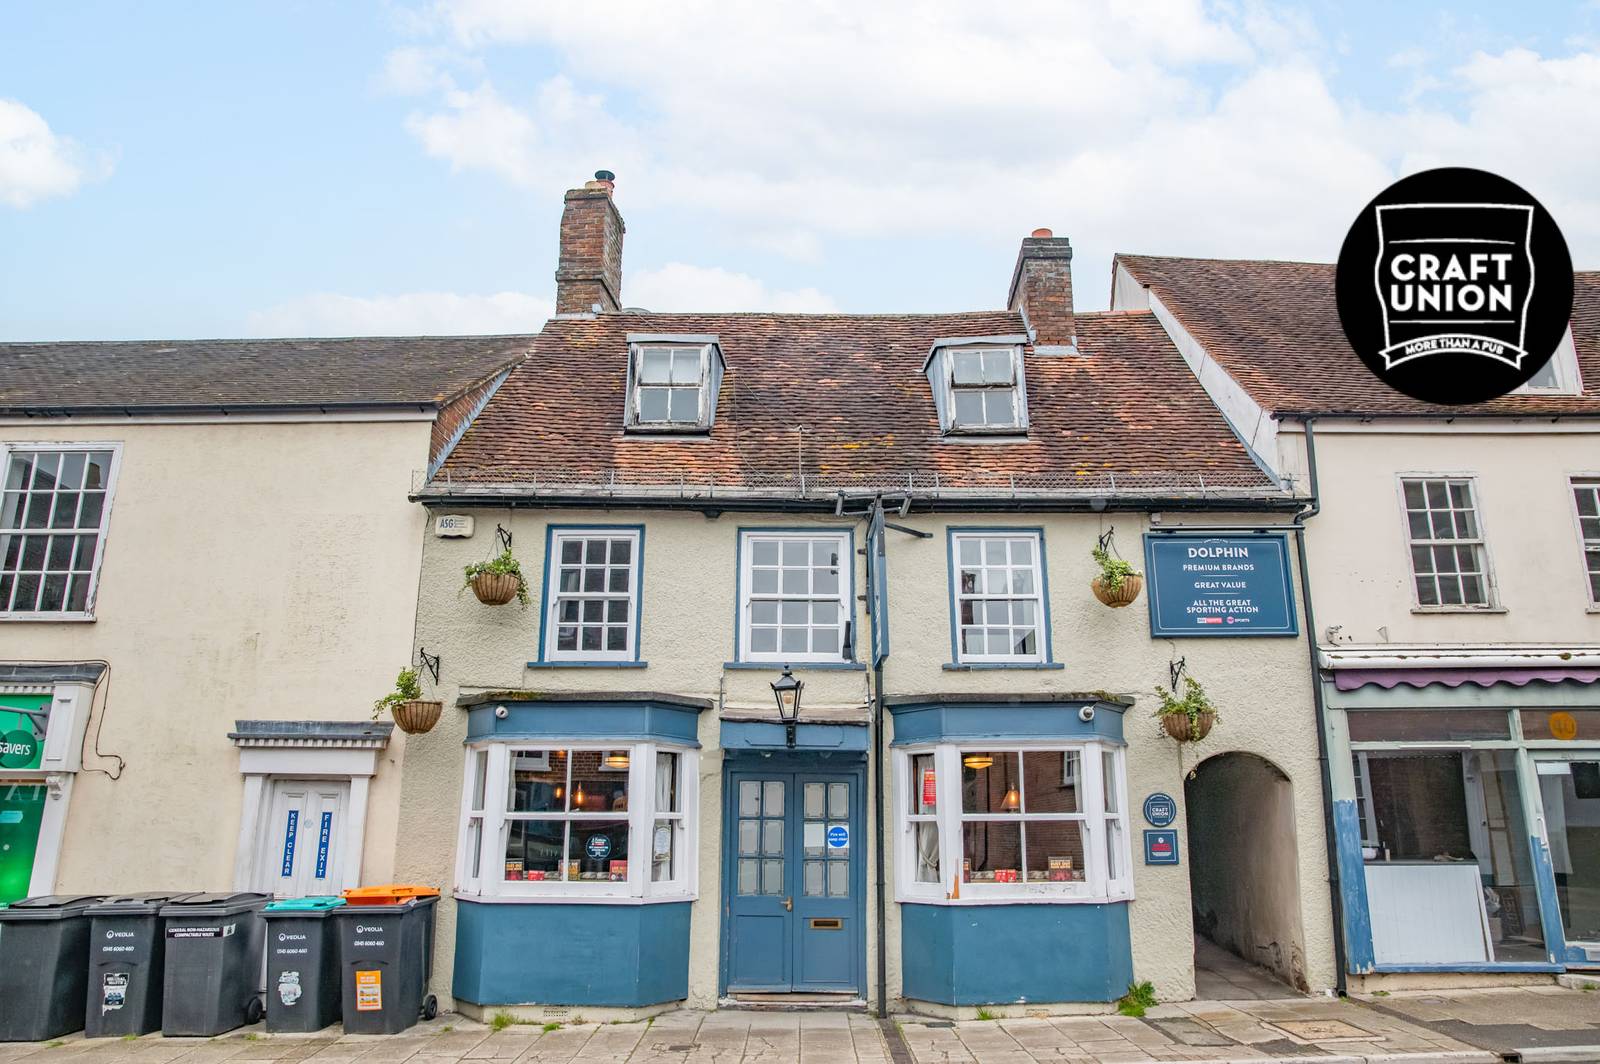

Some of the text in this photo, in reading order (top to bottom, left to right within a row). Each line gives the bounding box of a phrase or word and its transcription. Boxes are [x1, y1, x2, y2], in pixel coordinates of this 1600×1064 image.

[440, 518, 454, 528] ASG
[1187, 547, 1249, 558] DOLPHIN
[1221, 563, 1255, 571] BRANDS
[1194, 581, 1220, 589] GREAT
[1193, 599, 1208, 607] ALL
[1186, 606, 1227, 614] SPORTING
[284, 812, 296, 875] KEEP CLEAR
[318, 814, 330, 876] FIRE EXIT
